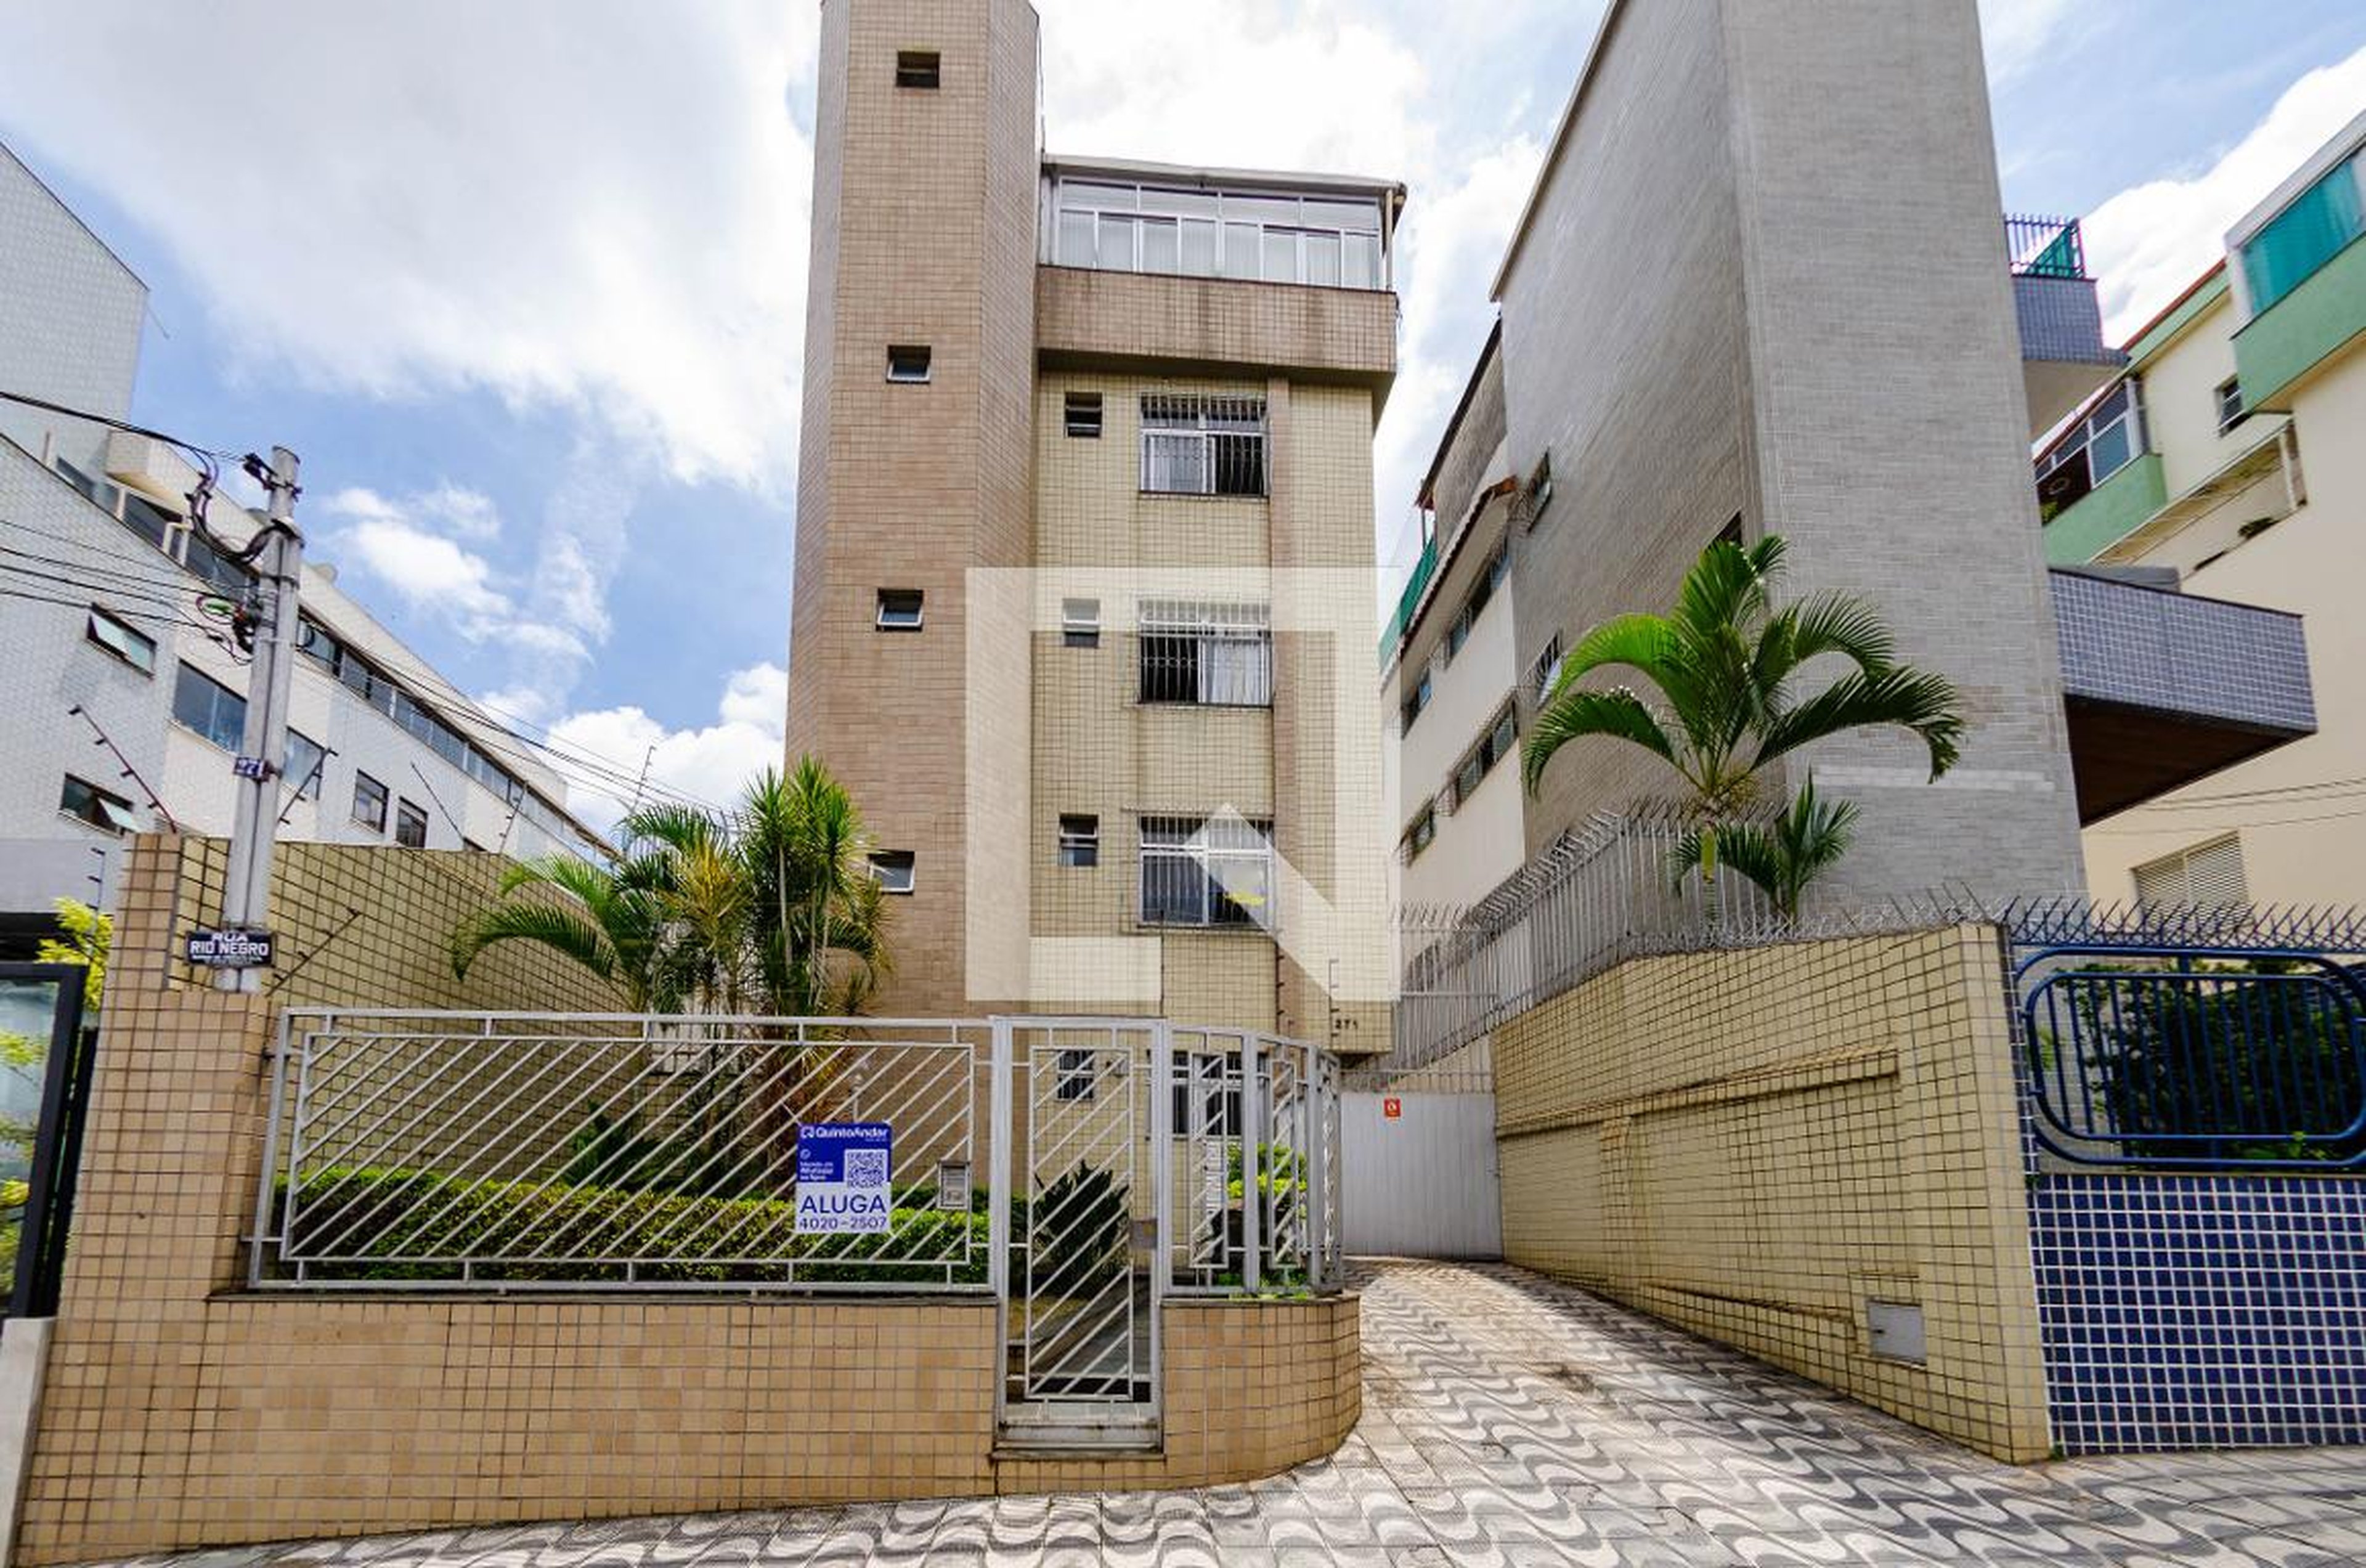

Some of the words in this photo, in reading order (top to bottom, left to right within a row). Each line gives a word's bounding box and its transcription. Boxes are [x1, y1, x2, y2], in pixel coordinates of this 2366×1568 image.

[212, 932, 249, 943] RUA
[190, 941, 215, 954] RIO
[219, 942, 269, 956] NEGRO
[815, 1126, 888, 1139] QuintoAndar
[800, 1194, 887, 1214] ALUGA
